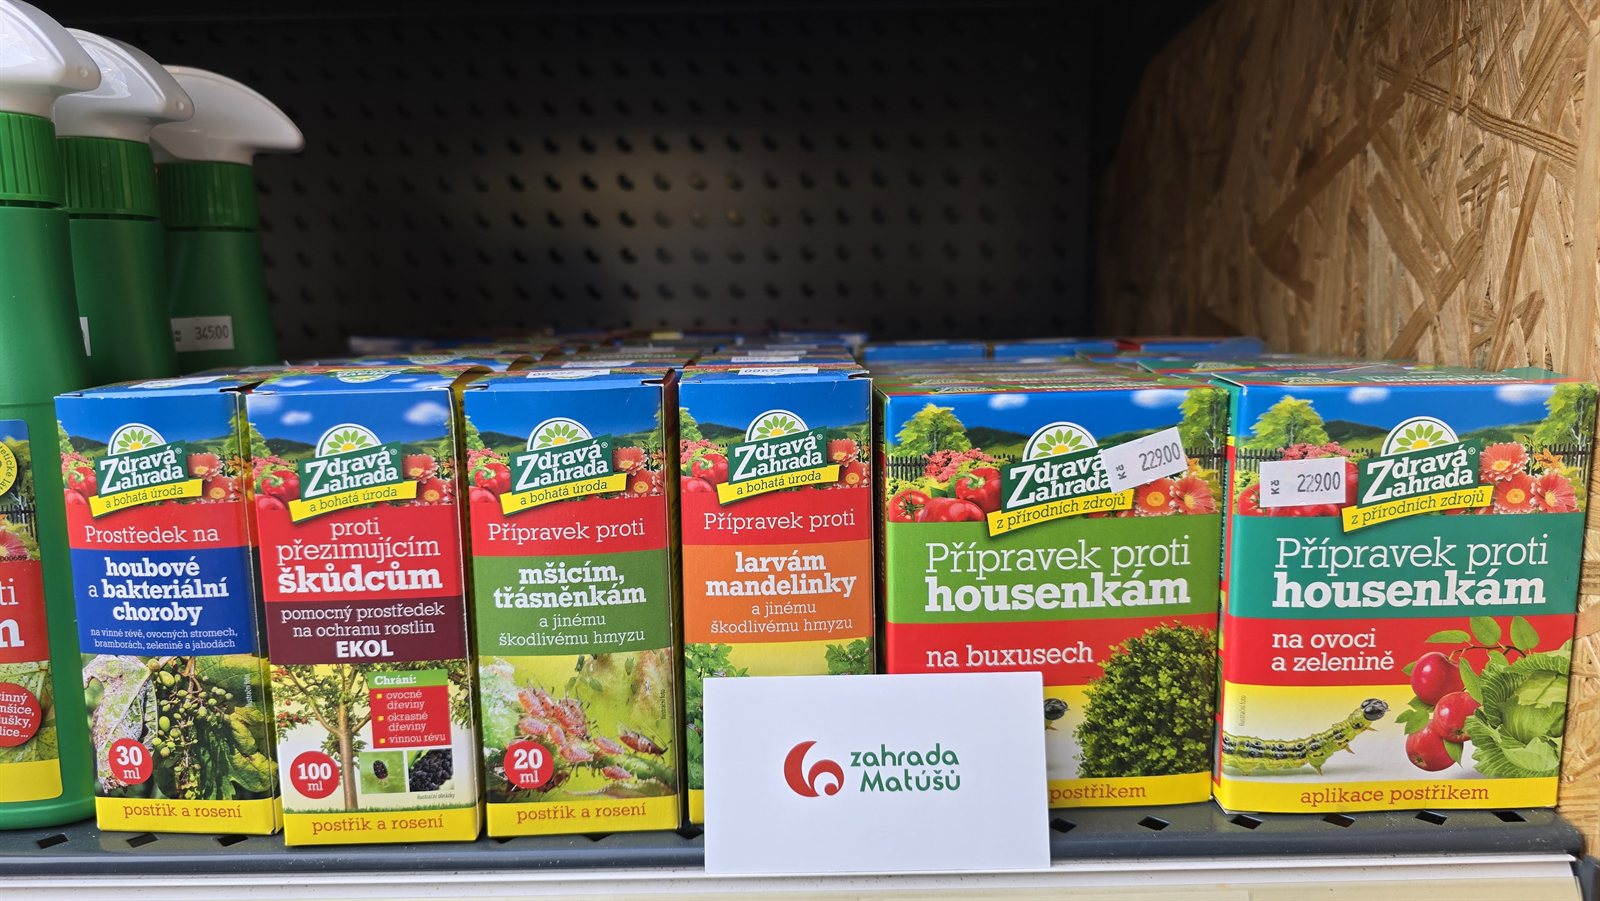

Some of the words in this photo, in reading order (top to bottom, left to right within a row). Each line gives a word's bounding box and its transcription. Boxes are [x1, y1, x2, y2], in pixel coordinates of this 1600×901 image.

[516, 440, 602, 478] Zdravá
[735, 432, 817, 469] Zdravá
[100, 447, 177, 482] Zdravá
[305, 446, 391, 484] Zdravá
[1366, 444, 1468, 489] Zdravá
[520, 496, 527, 505] a
[530, 486, 569, 503] bohatá
[572, 480, 608, 494] úroda
[736, 487, 744, 495] a
[746, 476, 785, 493] bohatá
[788, 470, 821, 485] úroda
[105, 502, 112, 510] a
[113, 490, 148, 507] bohatá
[151, 483, 184, 499] úroda
[309, 504, 317, 513] a
[319, 494, 359, 511] bohatá
[362, 486, 397, 501] úroda
[996, 519, 1004, 529] z
[1008, 500, 1079, 529] přírodních
[1083, 493, 1125, 511] zdrojů
[1351, 514, 1359, 526] z
[1362, 496, 1437, 527] přírodních
[1440, 489, 1485, 507] zdrojů
[330, 517, 381, 540] proti
[488, 522, 590, 545] Přípravek
[596, 518, 646, 543] proti
[703, 512, 803, 534] Přípravek
[809, 508, 856, 533] proti
[84, 525, 188, 544] Prostředek
[192, 528, 220, 542] na
[276, 536, 441, 566] přezimujícím
[735, 550, 826, 573] larvám
[925, 539, 1101, 580] Přípravek
[1110, 535, 1191, 576] proti
[1275, 537, 1457, 577] Přípravek
[1467, 533, 1549, 574] proti
[104, 556, 200, 577] houbové
[278, 561, 443, 594] škůdcům
[518, 561, 625, 585] mšicím,
[88, 584, 98, 598] a
[101, 576, 229, 599] bakteriální
[705, 572, 857, 598] mandelinky
[924, 569, 1191, 613] housenkám
[1271, 570, 1546, 608] housenkám
[493, 584, 647, 609] třásněnkám
[113, 602, 203, 626] choroby
[281, 605, 352, 623] pomocný
[356, 602, 445, 621] prostředek
[751, 605, 760, 615] a
[764, 601, 817, 618] jinému
[293, 625, 312, 638] na
[316, 622, 381, 637] ochranu
[385, 620, 435, 635] rostlin
[539, 617, 549, 628] a
[552, 613, 606, 630] jinému
[711, 619, 799, 634] škodlivému
[803, 618, 853, 633] hmyzu
[90, 629, 101, 637] na
[101, 628, 123, 638] vinné
[124, 629, 146, 639] révě,
[146, 629, 189, 640] ovocných
[190, 628, 238, 638] stromech,
[94, 639, 145, 650] bramborách,
[146, 640, 184, 650] zelenině
[184, 642, 191, 650] a
[191, 639, 236, 651] jahodách
[499, 631, 589, 646] škodlivému
[593, 630, 645, 646] hmyzu
[1271, 632, 1304, 649] na
[1310, 628, 1377, 649] ovoci
[336, 639, 394, 659] EKOL
[926, 650, 959, 668] na
[966, 641, 1094, 667] buxusech
[1271, 656, 1286, 672] a
[1292, 651, 1395, 672] zelenině
[374, 674, 417, 685] Chrání:
[0, 691, 28, 705] inný
[386, 691, 422, 700] ovocné
[387, 700, 425, 710] dřeviny
[0, 715, 32, 729] ušky,
[387, 711, 428, 722] okrasné
[388, 722, 426, 732] dřeviny
[388, 734, 422, 744] vinnou
[424, 733, 447, 742] révu
[116, 745, 143, 766] 30
[513, 748, 543, 770] 20
[850, 743, 960, 767] zahrada
[123, 768, 141, 780] ml
[297, 762, 332, 780] 100
[519, 770, 540, 783] ml
[860, 768, 961, 793] Matúšů
[307, 781, 323, 791] ml
[1049, 784, 1146, 803] postřikem
[1300, 785, 1384, 806] aplikace
[1390, 784, 1490, 809] postřikem
[123, 804, 175, 818] postřik
[181, 807, 191, 817] a
[194, 804, 242, 818] rosení
[516, 806, 576, 823] postřik
[581, 808, 590, 817] a
[595, 802, 647, 818] rosení
[312, 817, 370, 835] postřik
[377, 820, 386, 830] a
[391, 814, 444, 830] rosení
